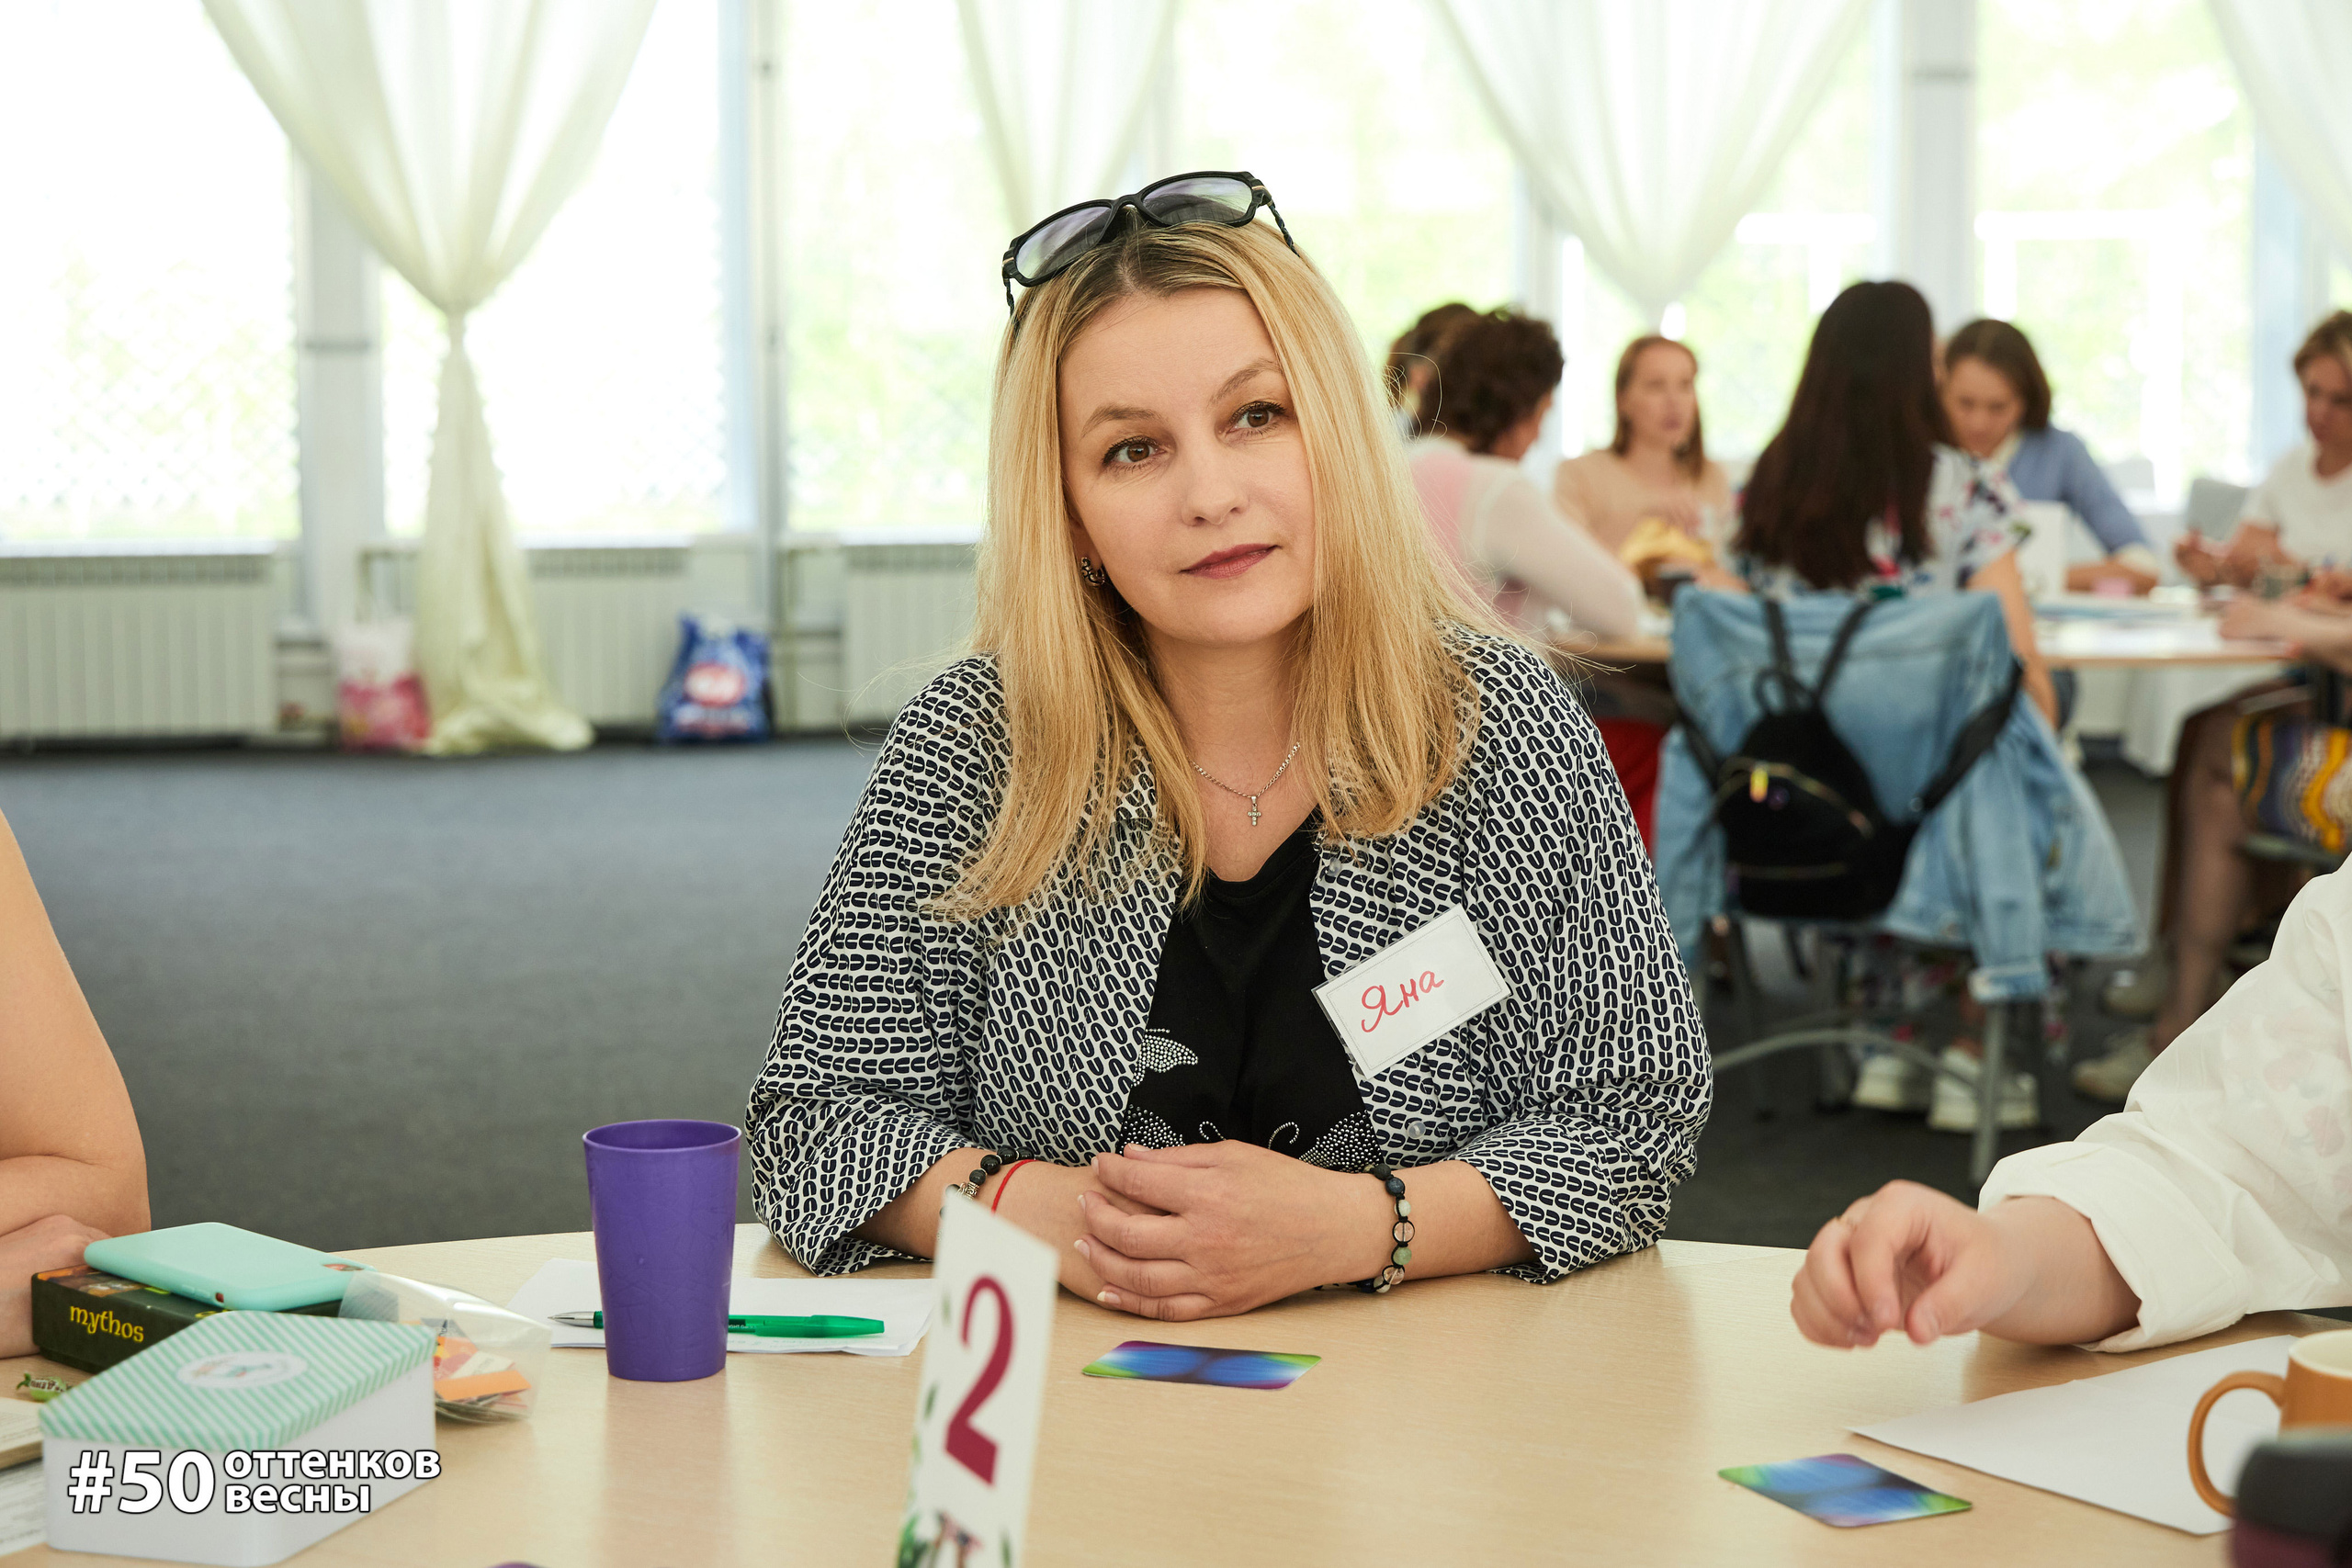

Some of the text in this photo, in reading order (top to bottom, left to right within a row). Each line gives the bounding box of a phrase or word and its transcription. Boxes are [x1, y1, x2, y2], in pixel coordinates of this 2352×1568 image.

[1361, 970, 1444, 1032] Яна
[70, 1305, 144, 1343] mythos
[944, 1275, 1014, 1486] 2
